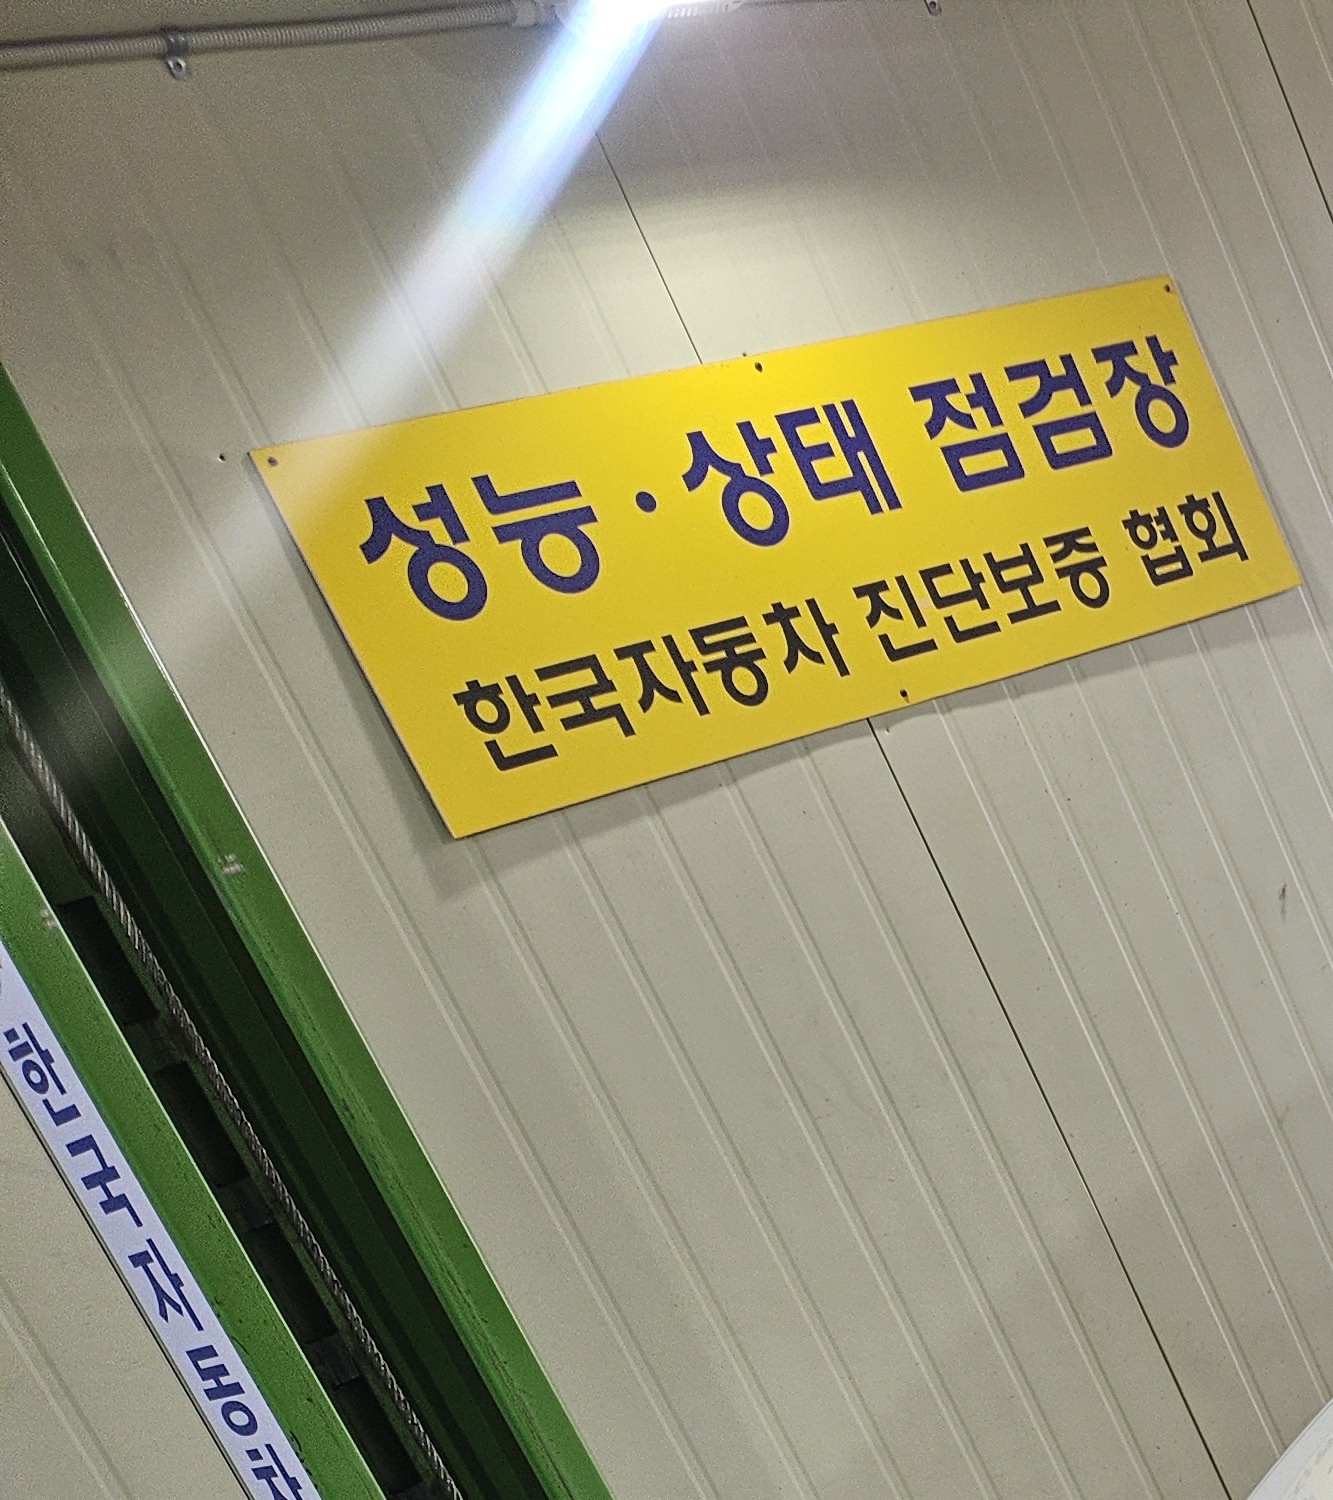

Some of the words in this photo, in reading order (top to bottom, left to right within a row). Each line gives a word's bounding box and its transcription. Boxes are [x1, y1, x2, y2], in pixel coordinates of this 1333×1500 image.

[908, 335, 1190, 492] 점검장
[454, 599, 851, 772] 한국자동차
[852, 526, 1110, 662] 진단보증
[1121, 491, 1249, 587] 협회
